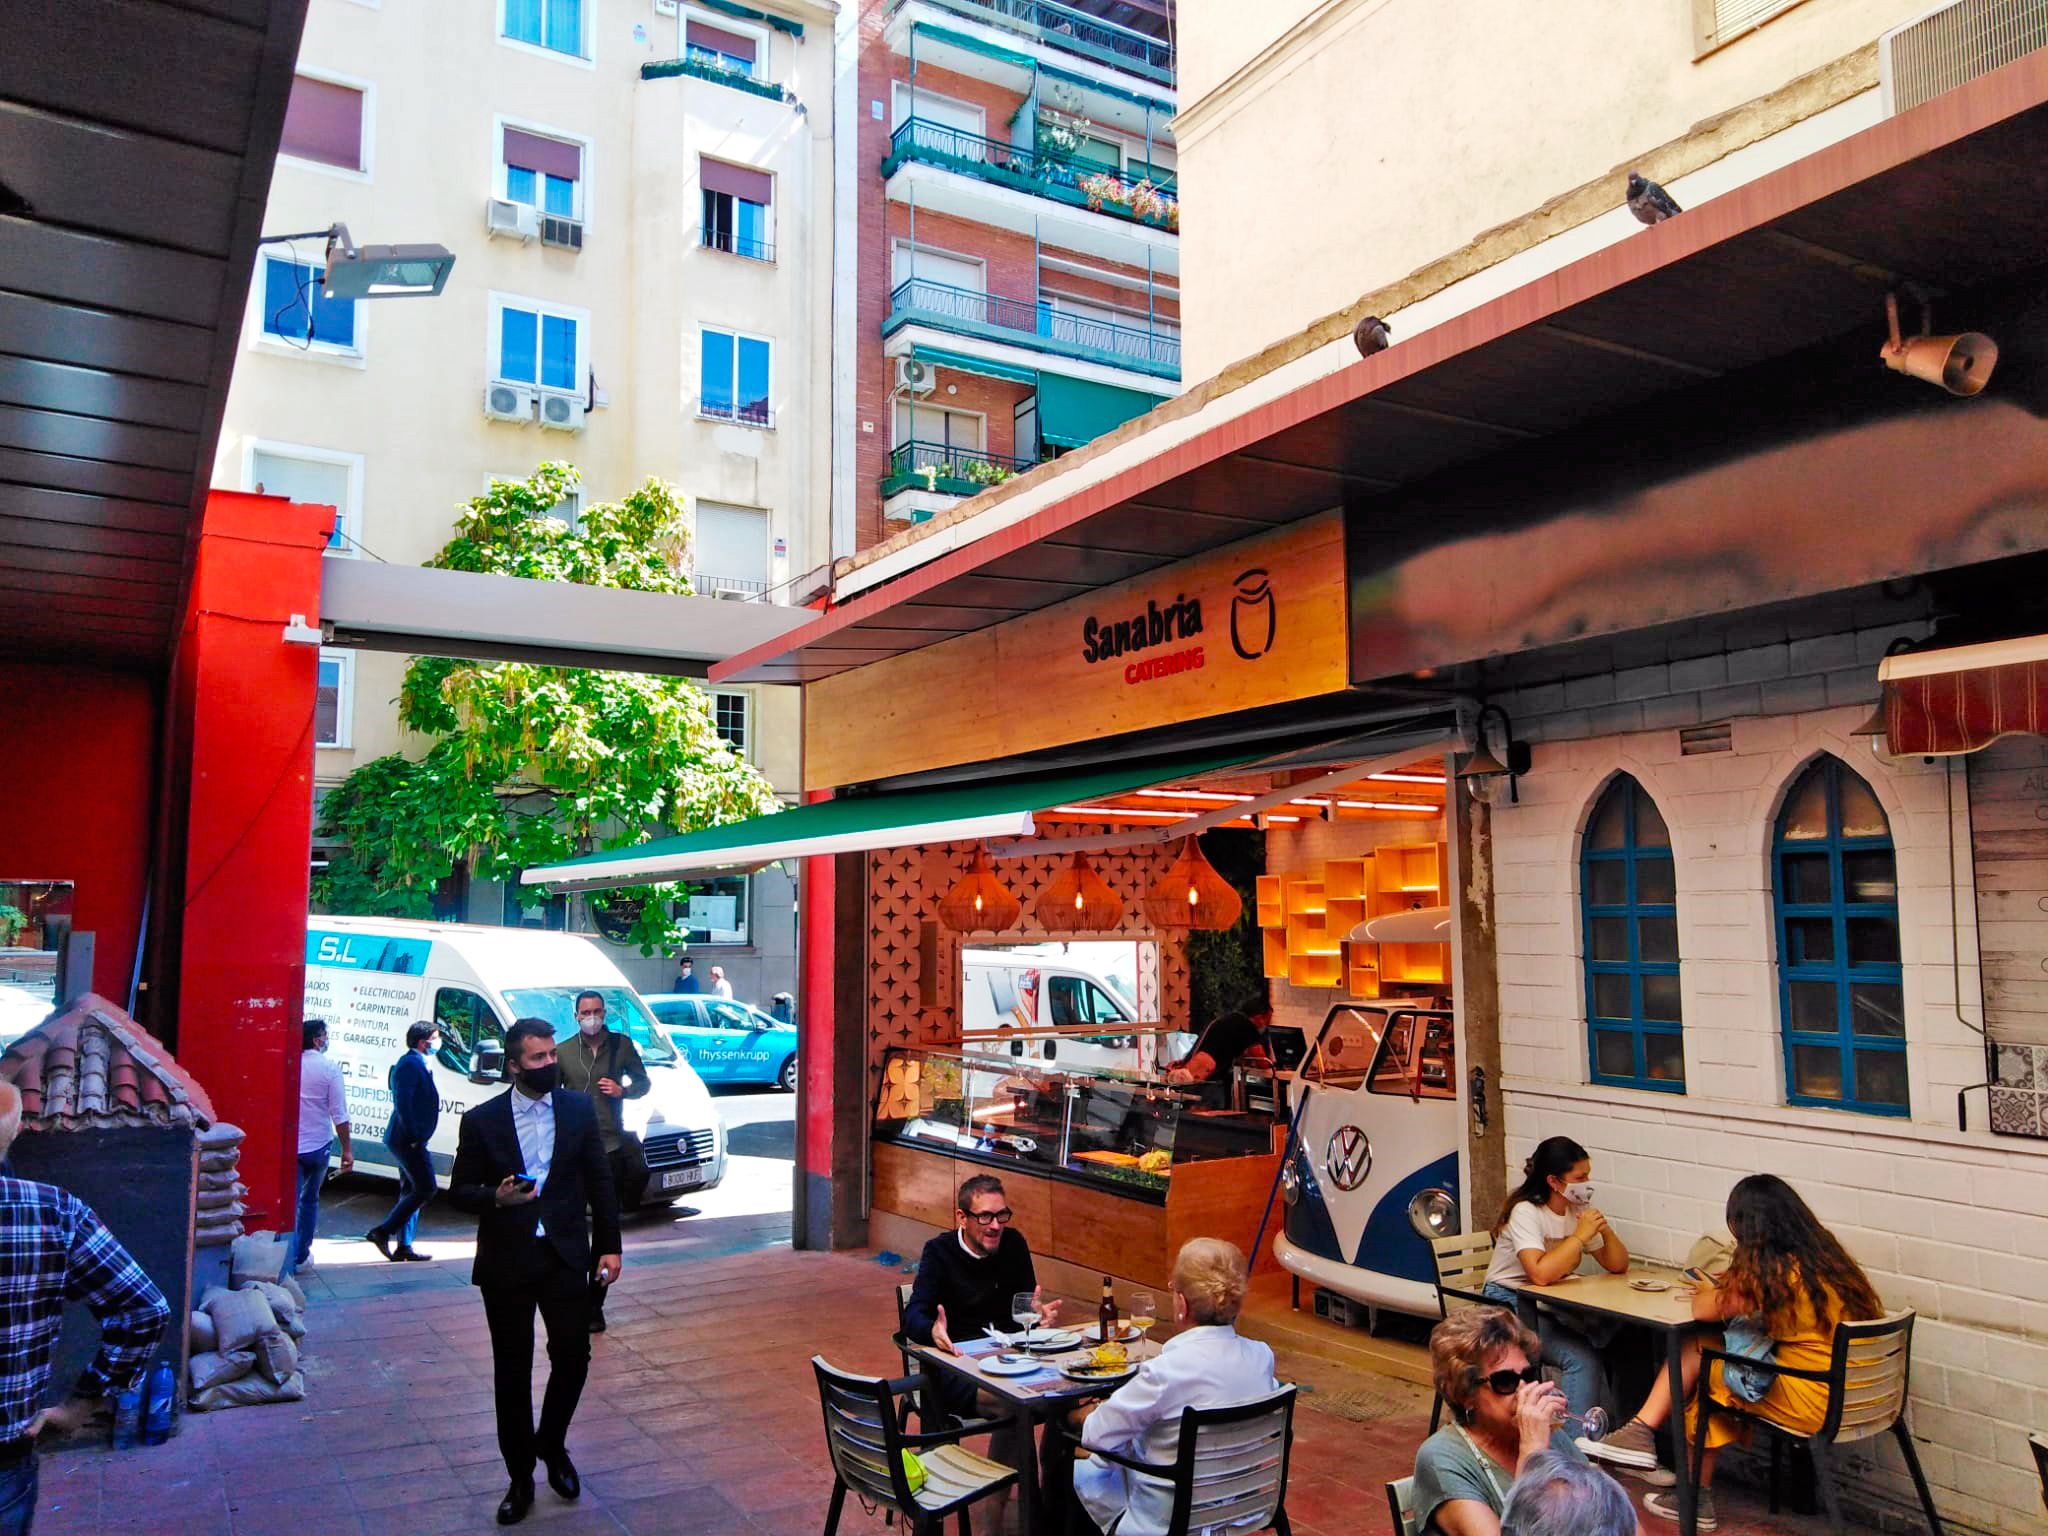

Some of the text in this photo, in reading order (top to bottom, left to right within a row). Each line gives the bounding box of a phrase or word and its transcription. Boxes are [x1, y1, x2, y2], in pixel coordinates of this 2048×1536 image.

[1082, 593, 1203, 664] Sanabria
[1124, 647, 1204, 684] CATERING
[317, 936, 357, 963] S.L
[359, 986, 416, 1001] ELECTRICIDAD
[353, 1018, 389, 1032] PINTURA
[699, 1048, 770, 1064] thyssenkrupp
